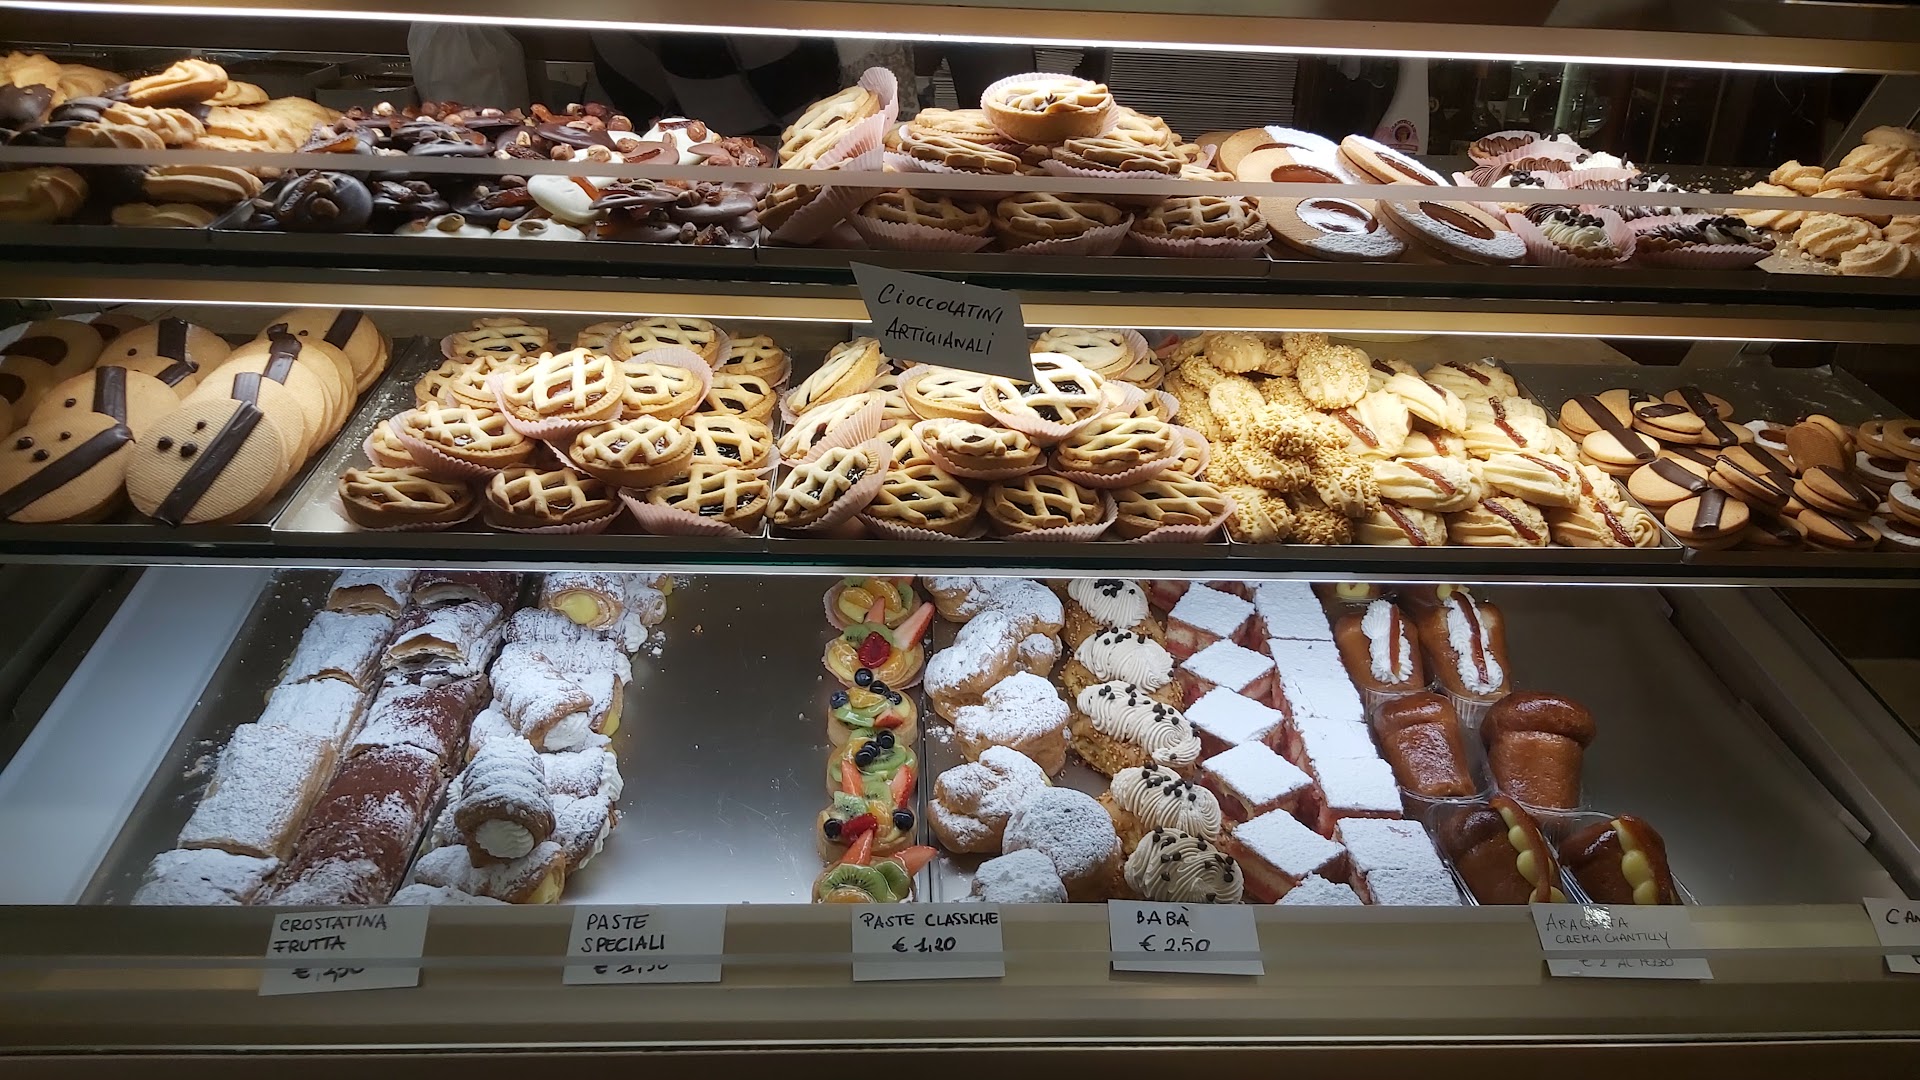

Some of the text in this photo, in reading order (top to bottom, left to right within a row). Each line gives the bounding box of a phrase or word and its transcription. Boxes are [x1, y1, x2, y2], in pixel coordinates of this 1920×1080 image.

[877, 283, 1003, 325] CIOCCOLATINI
[885, 316, 995, 356] ARTIGIANALI
[280, 913, 387, 933] CROSTATINA
[586, 913, 650, 931] PASTE
[859, 912, 999, 930] PASTE CLASSICHE
[1545, 913, 1629, 931] ARAGOTA
[272, 935, 347, 954] FRUTTA
[580, 934, 666, 953] SPECIALI
[891, 936, 957, 953] € 1,20
[1138, 934, 1157, 952] €
[1555, 931, 1671, 949] CREMA CHANTILLY
